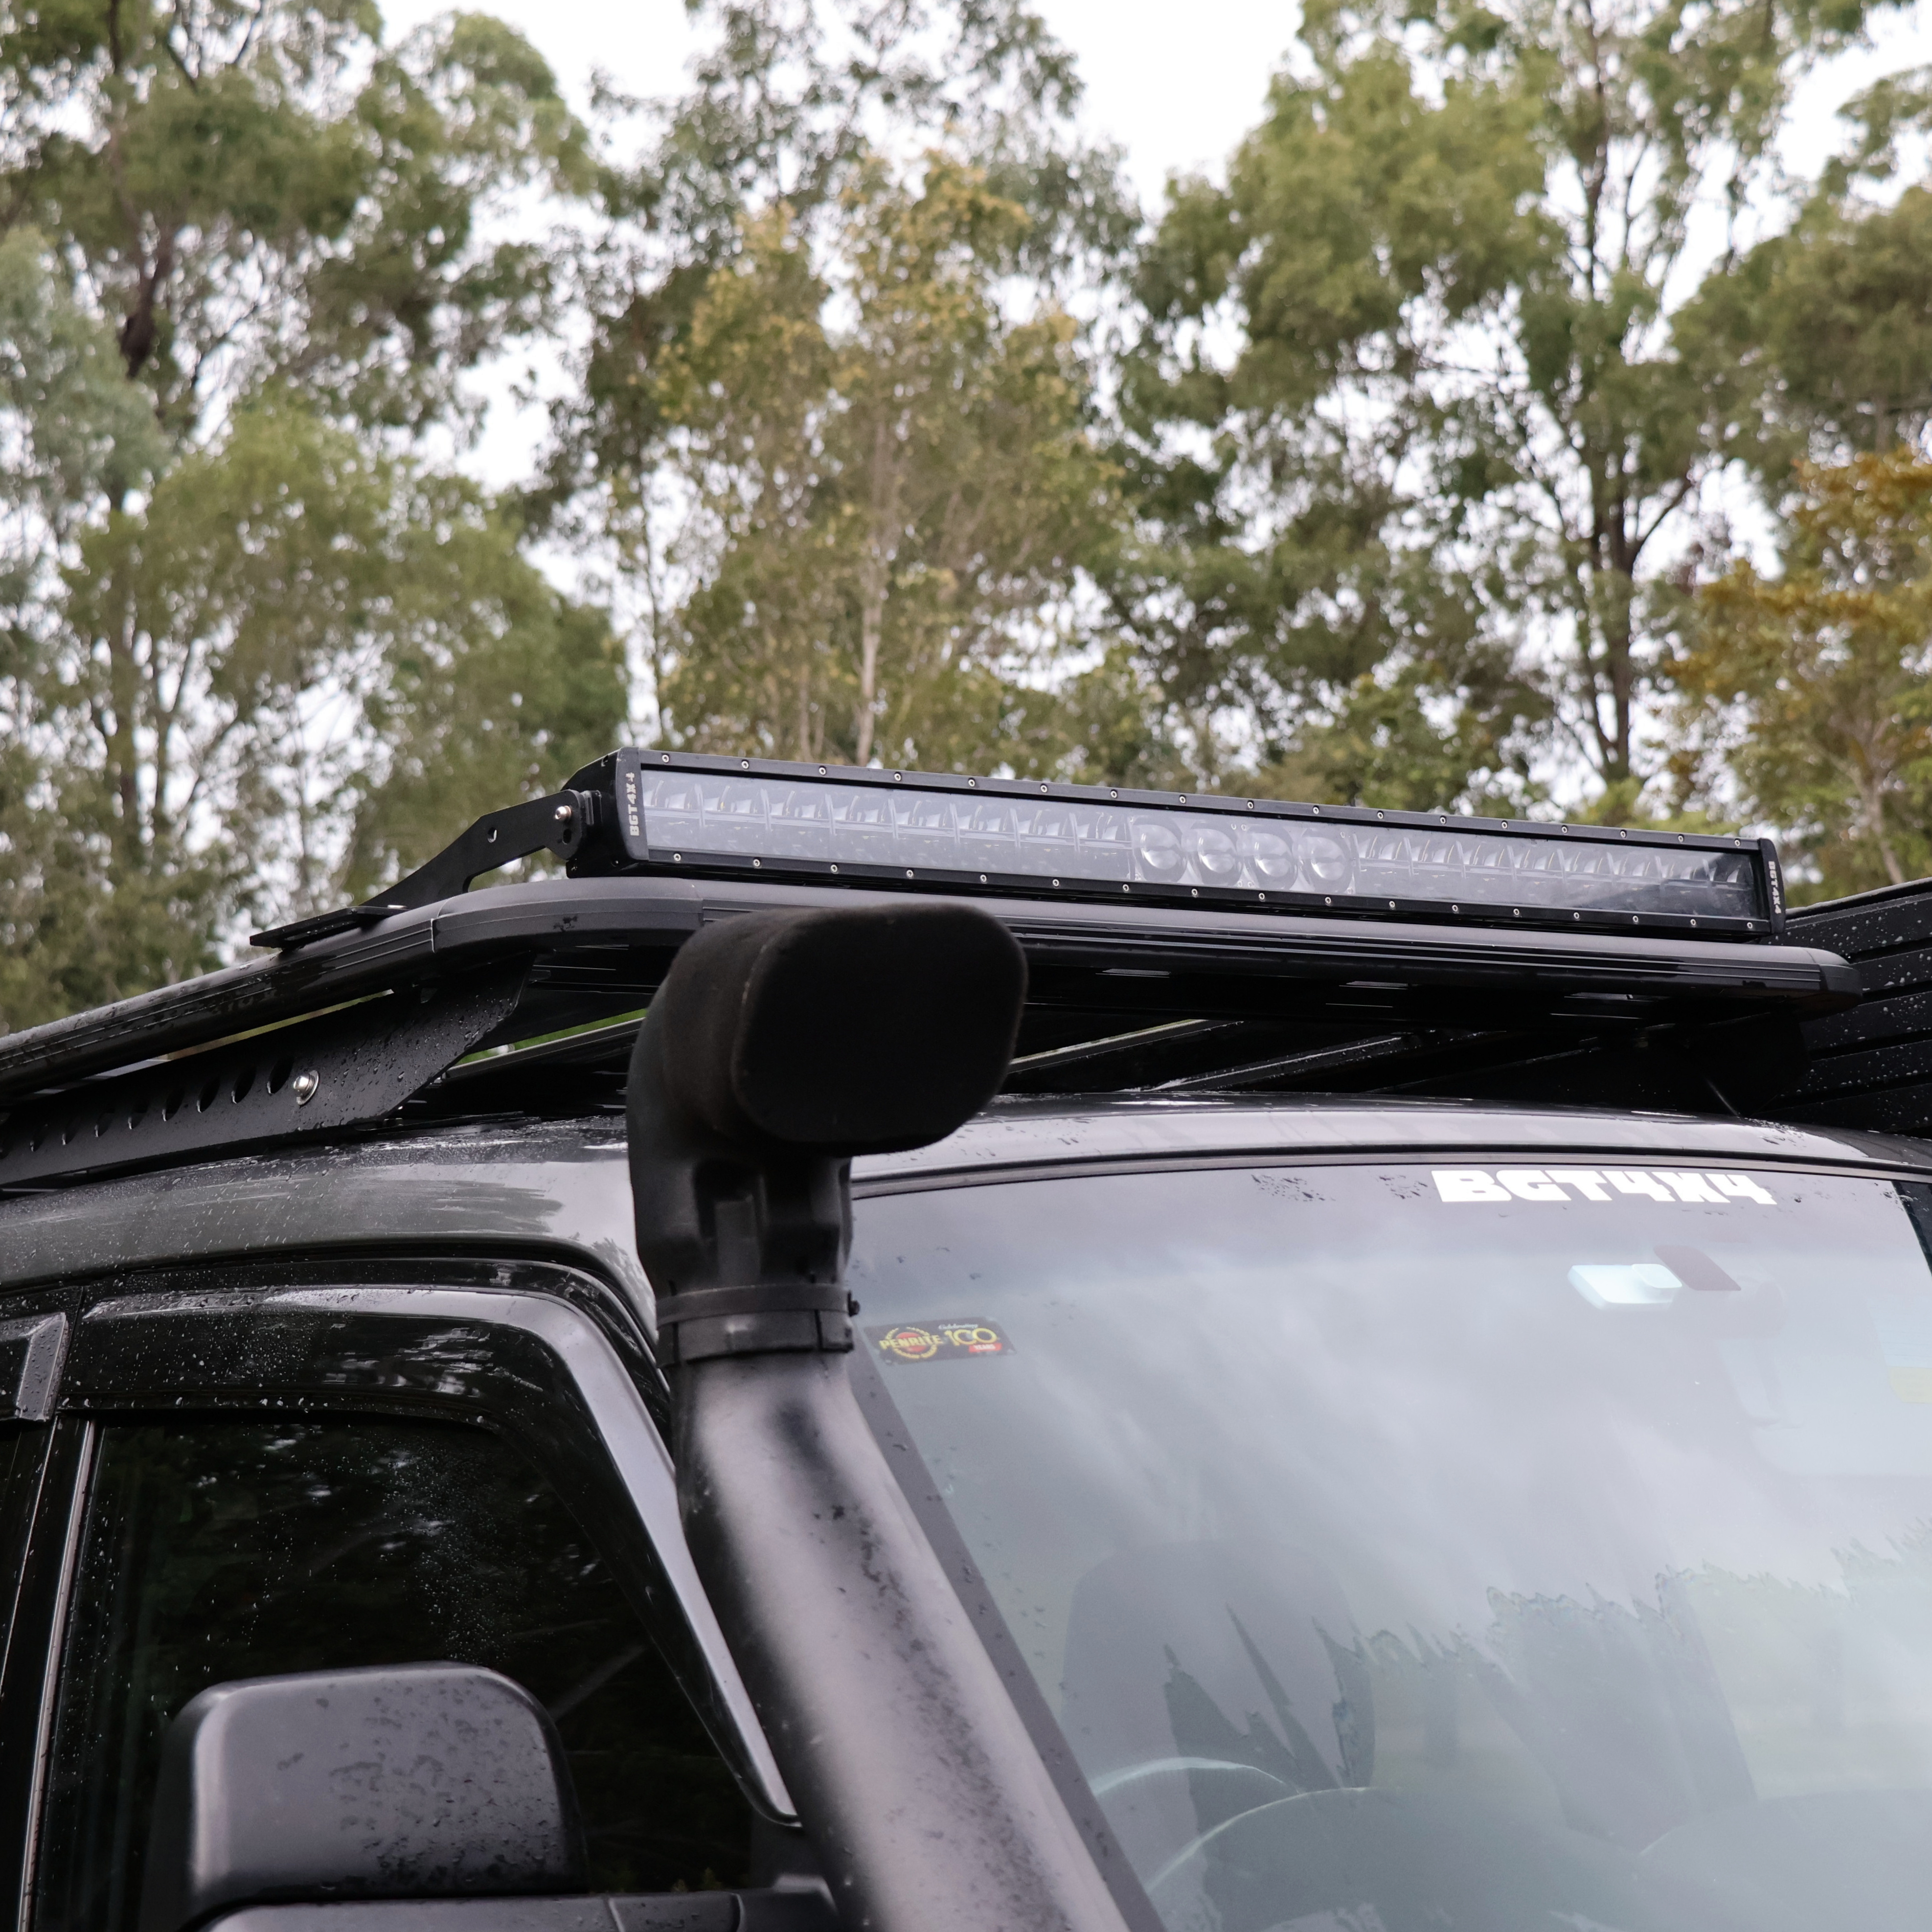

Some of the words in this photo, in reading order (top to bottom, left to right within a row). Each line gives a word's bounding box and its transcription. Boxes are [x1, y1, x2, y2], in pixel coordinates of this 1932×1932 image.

[626, 772, 639, 836] BGT4X4
[1769, 861, 1781, 913] BGT4X4
[1431, 1170, 1777, 1205] BGT4X4
[879, 1335, 944, 1350] PENRITE
[944, 1328, 997, 1346] 100
